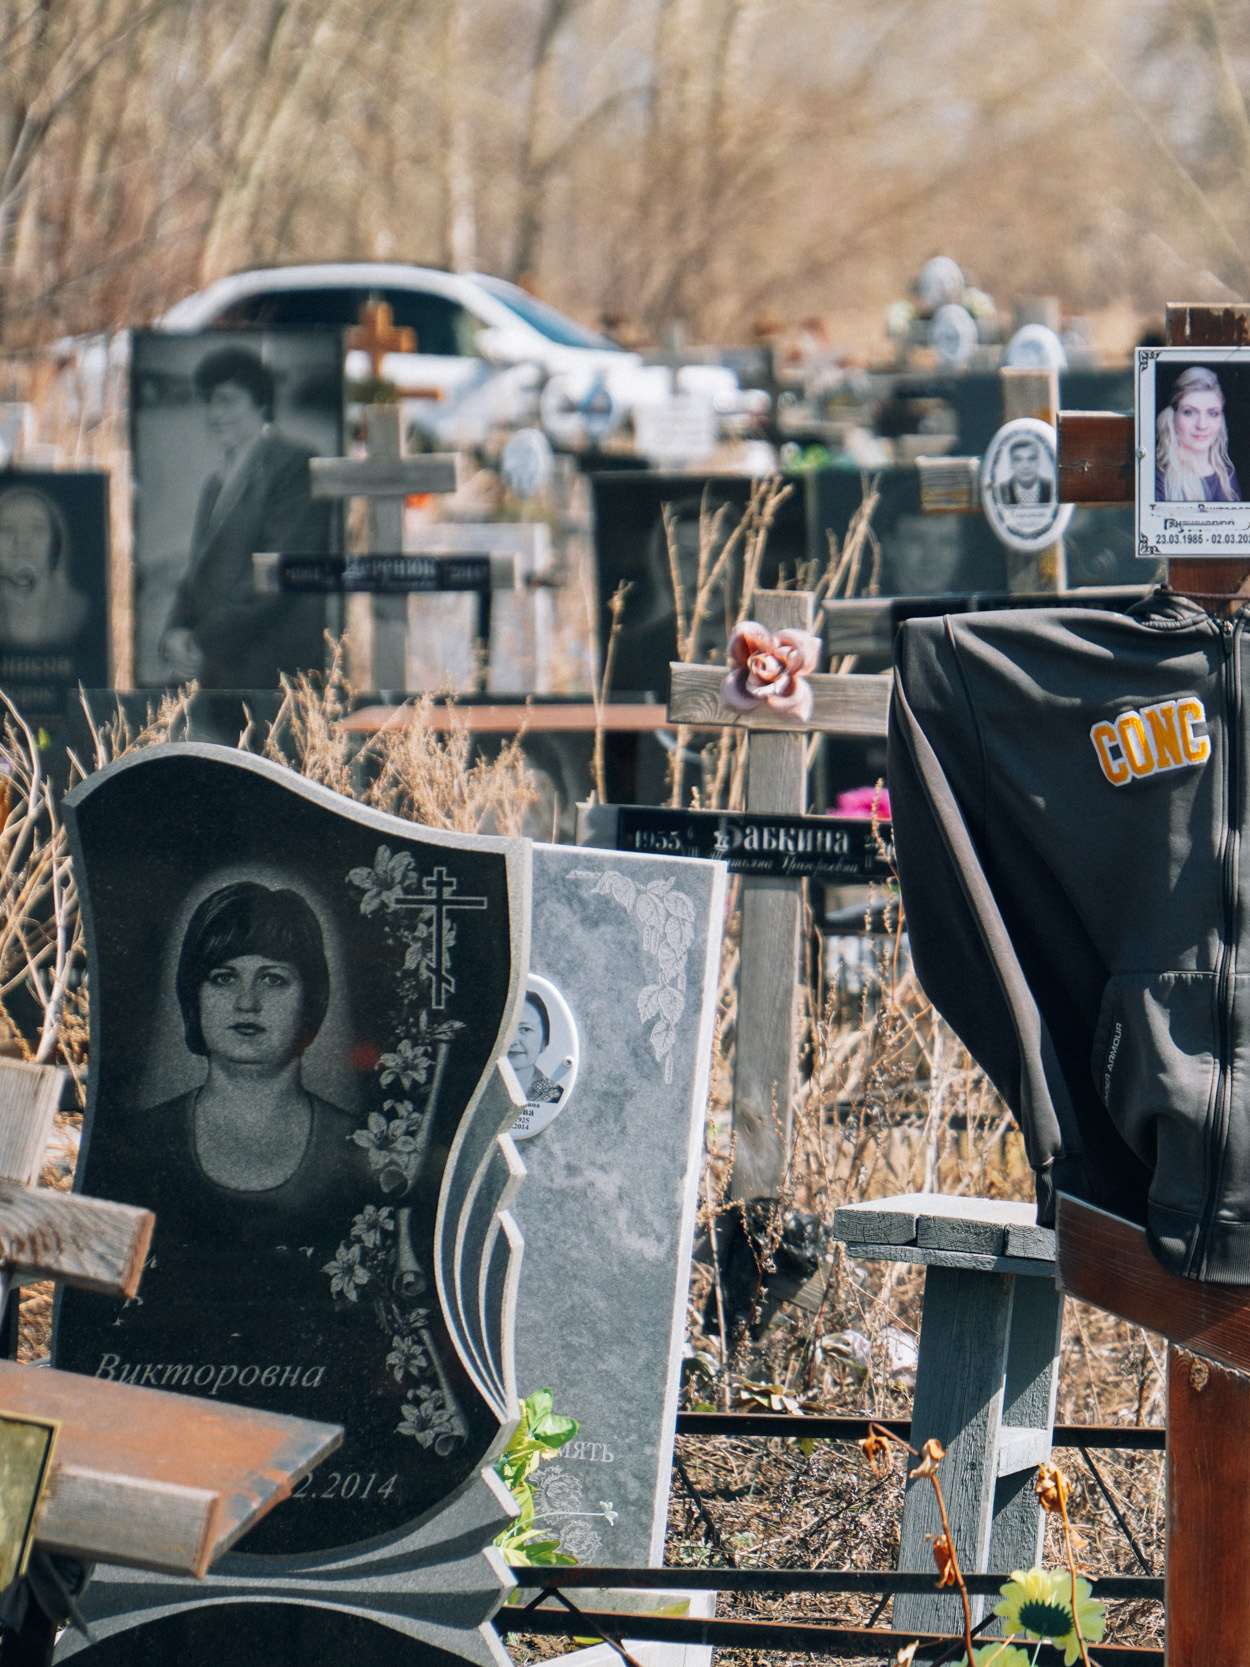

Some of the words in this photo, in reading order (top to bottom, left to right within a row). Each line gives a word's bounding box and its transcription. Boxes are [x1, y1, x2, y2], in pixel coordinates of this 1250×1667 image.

[1156, 533, 1203, 545] 23.03.1985
[1107, 1022, 1123, 1073] ARMOUR
[95, 1352, 327, 1395] Викторовна
